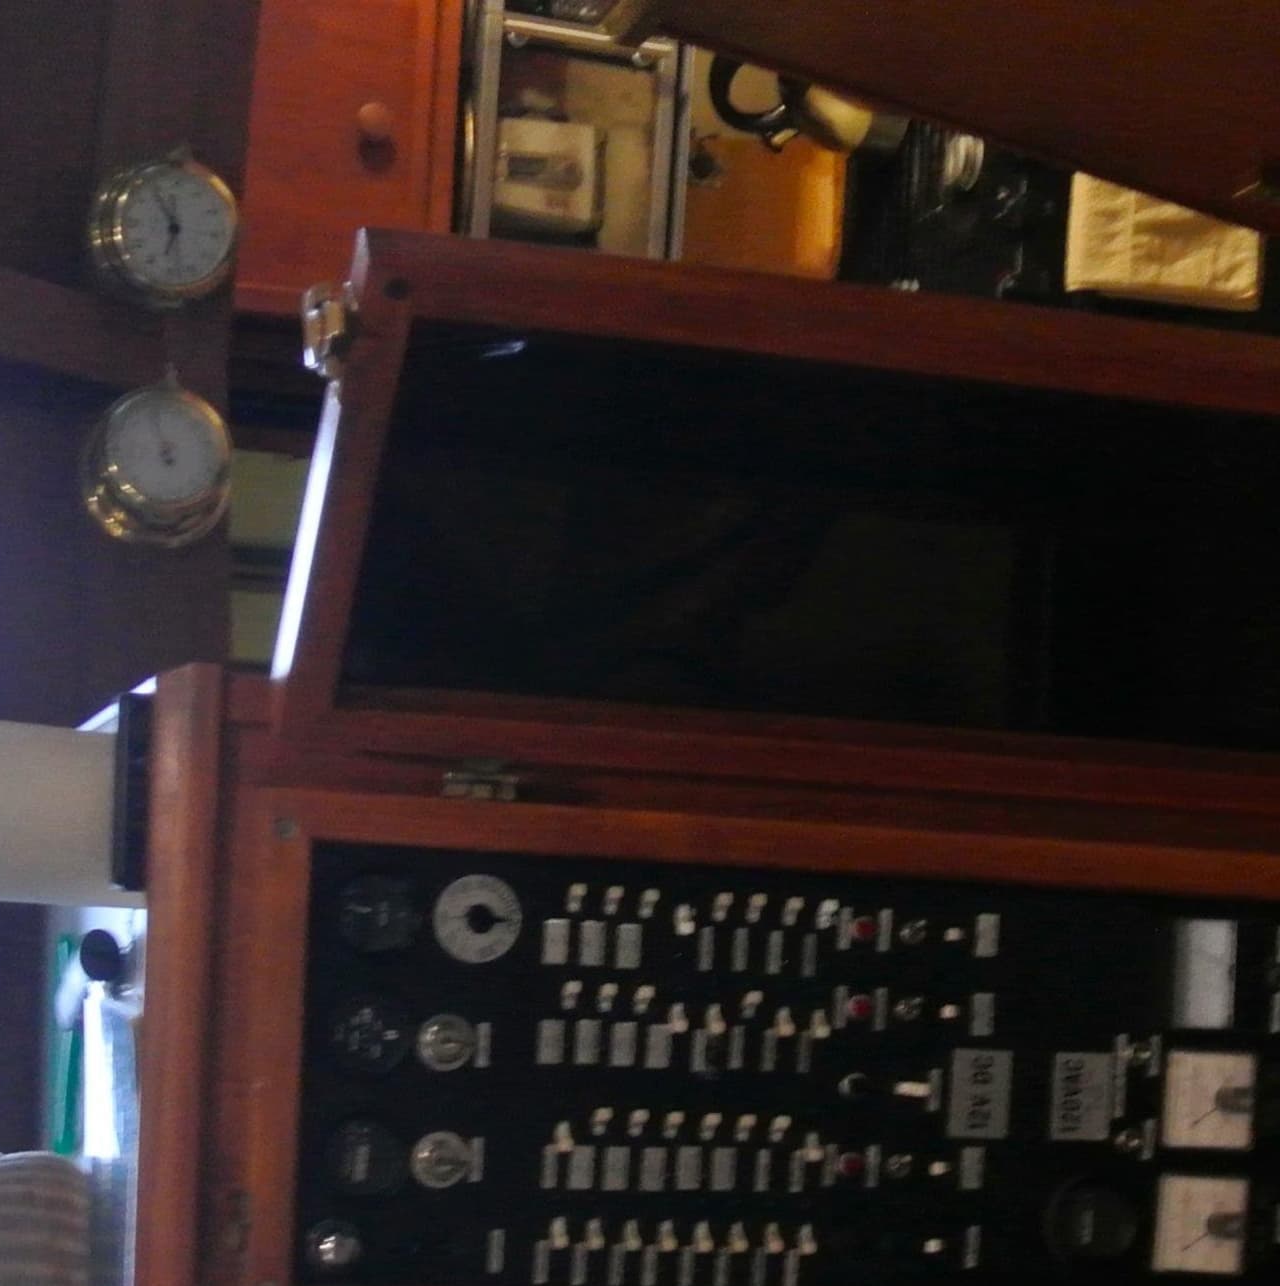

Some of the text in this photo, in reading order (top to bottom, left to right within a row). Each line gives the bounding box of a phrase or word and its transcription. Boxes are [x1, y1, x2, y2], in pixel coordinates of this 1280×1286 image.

[970, 1055, 993, 1086] DC
[966, 1095, 992, 1131] 12V
[1057, 1058, 1085, 1135] 120VAC
